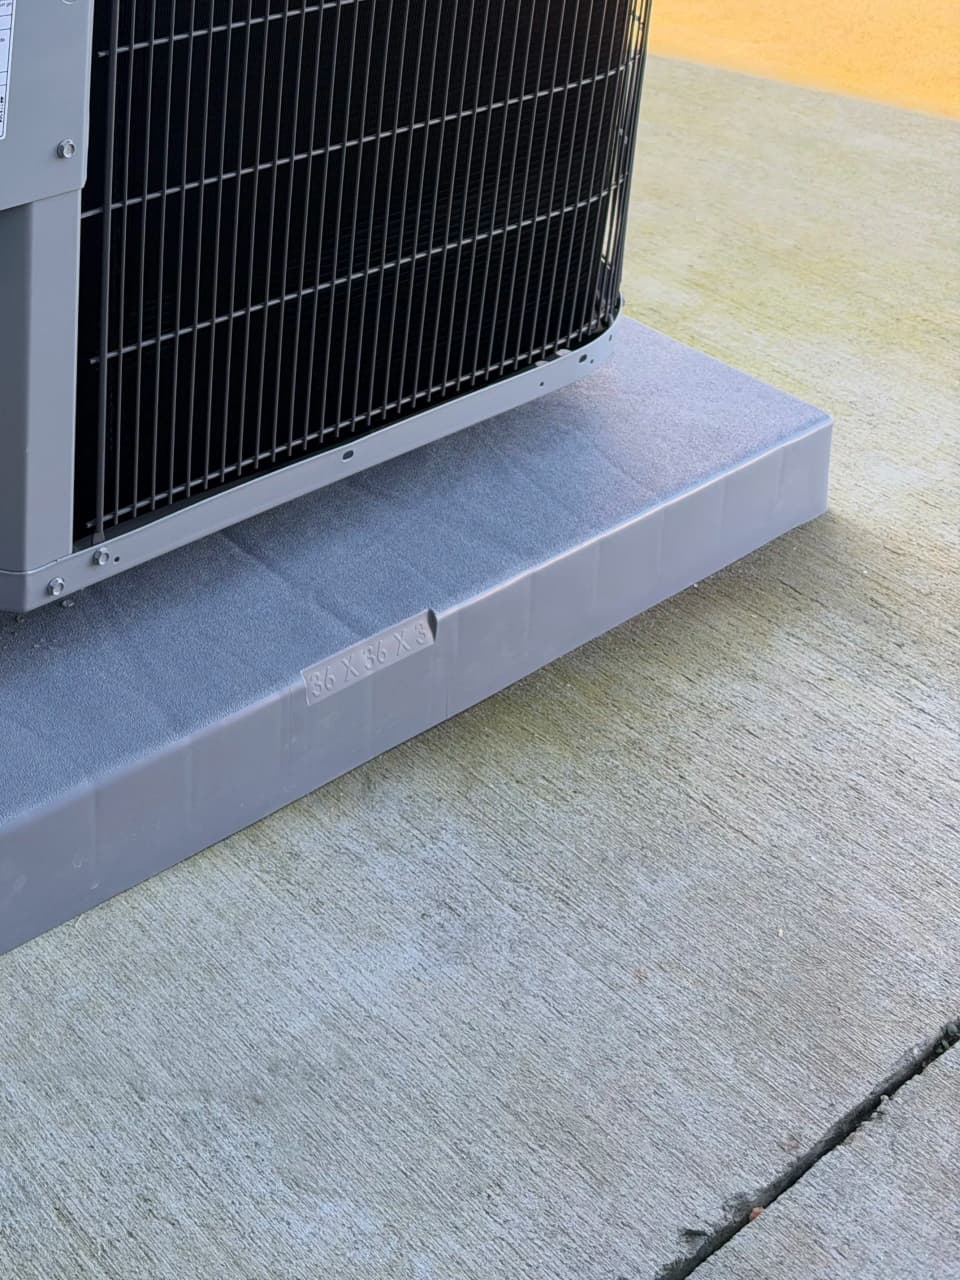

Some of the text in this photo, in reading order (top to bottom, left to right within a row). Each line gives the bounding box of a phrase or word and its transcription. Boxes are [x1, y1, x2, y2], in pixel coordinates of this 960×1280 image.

[308, 623, 427, 699] 36 X 36 X 3
